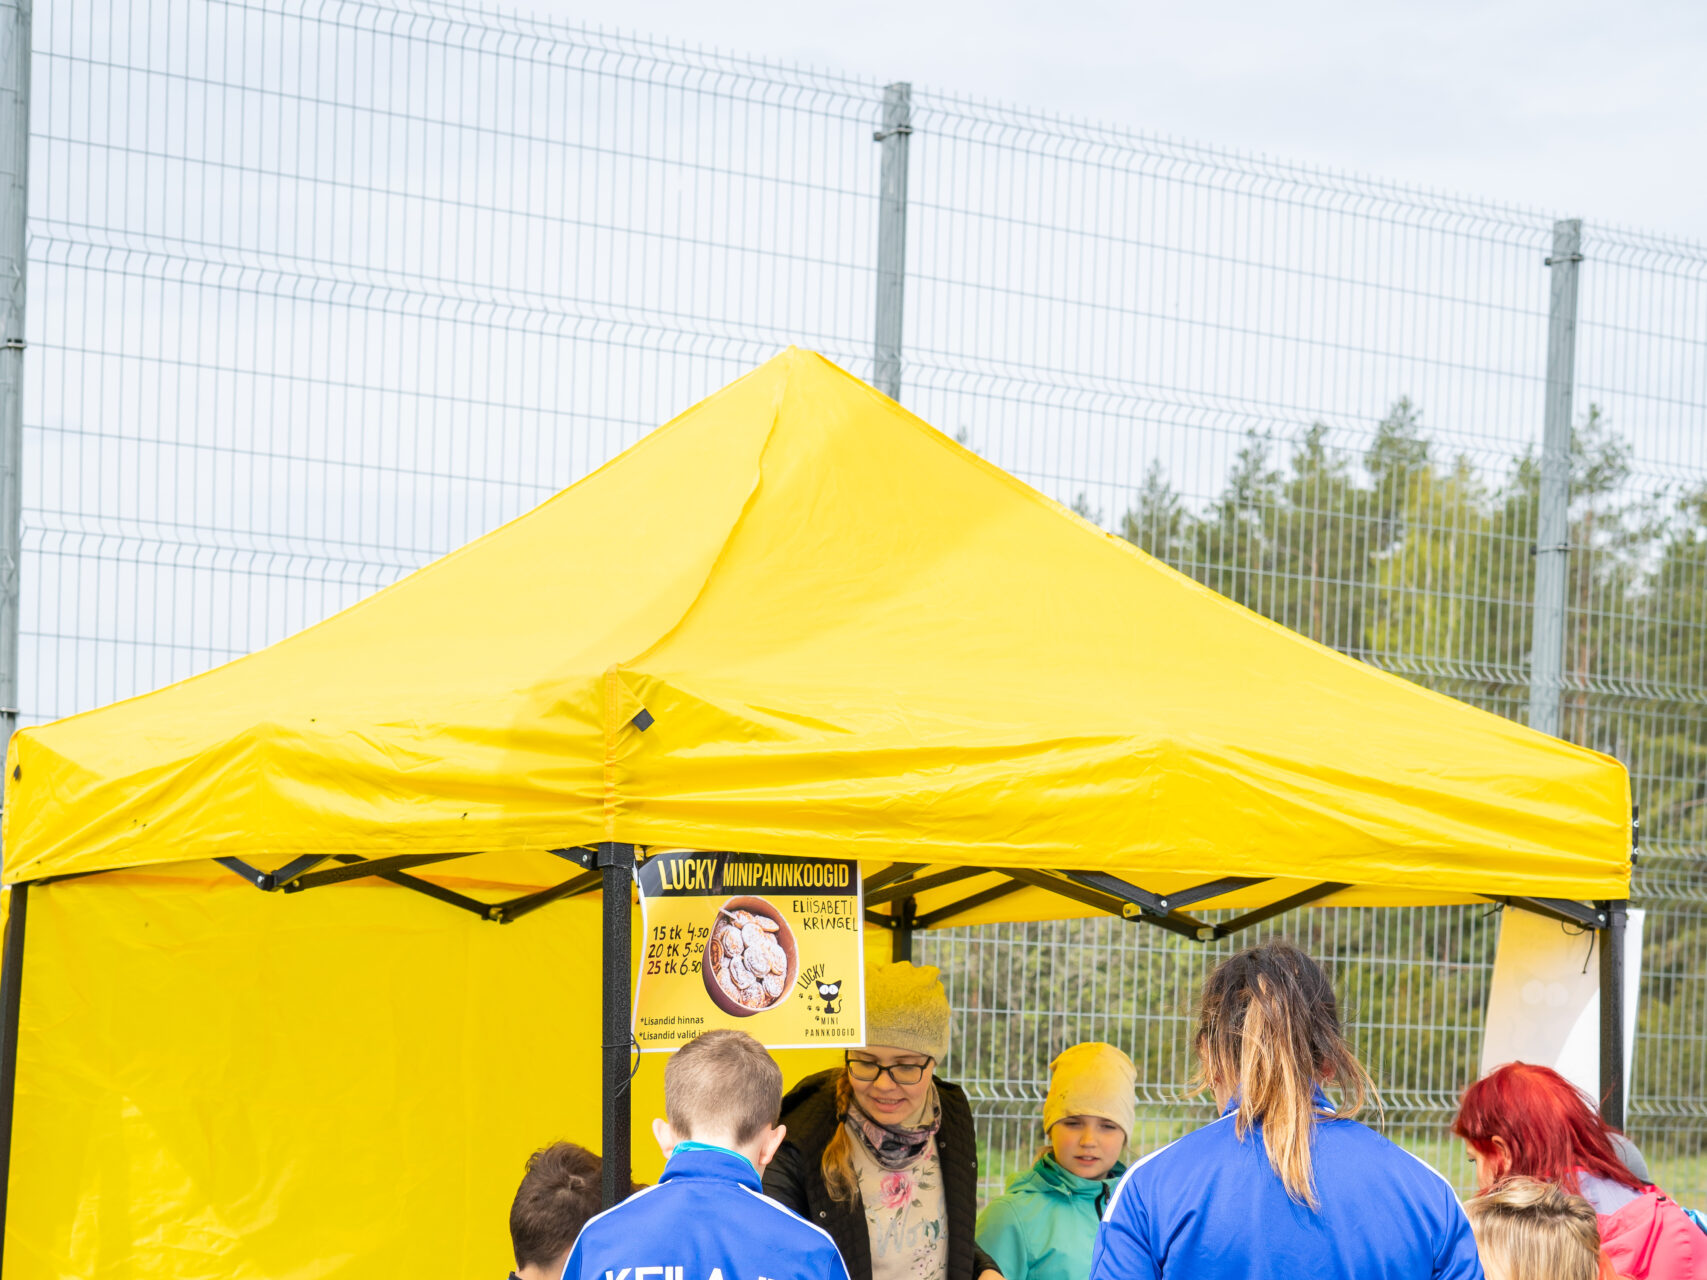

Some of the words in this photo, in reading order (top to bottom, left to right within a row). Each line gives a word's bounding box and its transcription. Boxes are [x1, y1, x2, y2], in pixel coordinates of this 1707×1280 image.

[657, 859, 717, 890] LUCKY
[723, 863, 849, 887] MINIPANNKOOGID
[653, 926, 666, 940] 15
[670, 925, 682, 940] tk
[687, 922, 709, 941] 4.50
[648, 944, 663, 958] 20
[683, 942, 704, 957] 5.50
[647, 960, 661, 975] 25
[665, 959, 677, 974] tk
[680, 958, 702, 975] 6.50
[797, 963, 825, 989] LUCKY
[677, 1016, 704, 1025] hinnas
[821, 1017, 839, 1025] MINI
[676, 1030, 697, 1039] valid
[805, 1028, 855, 1037] PANNKOOGID
